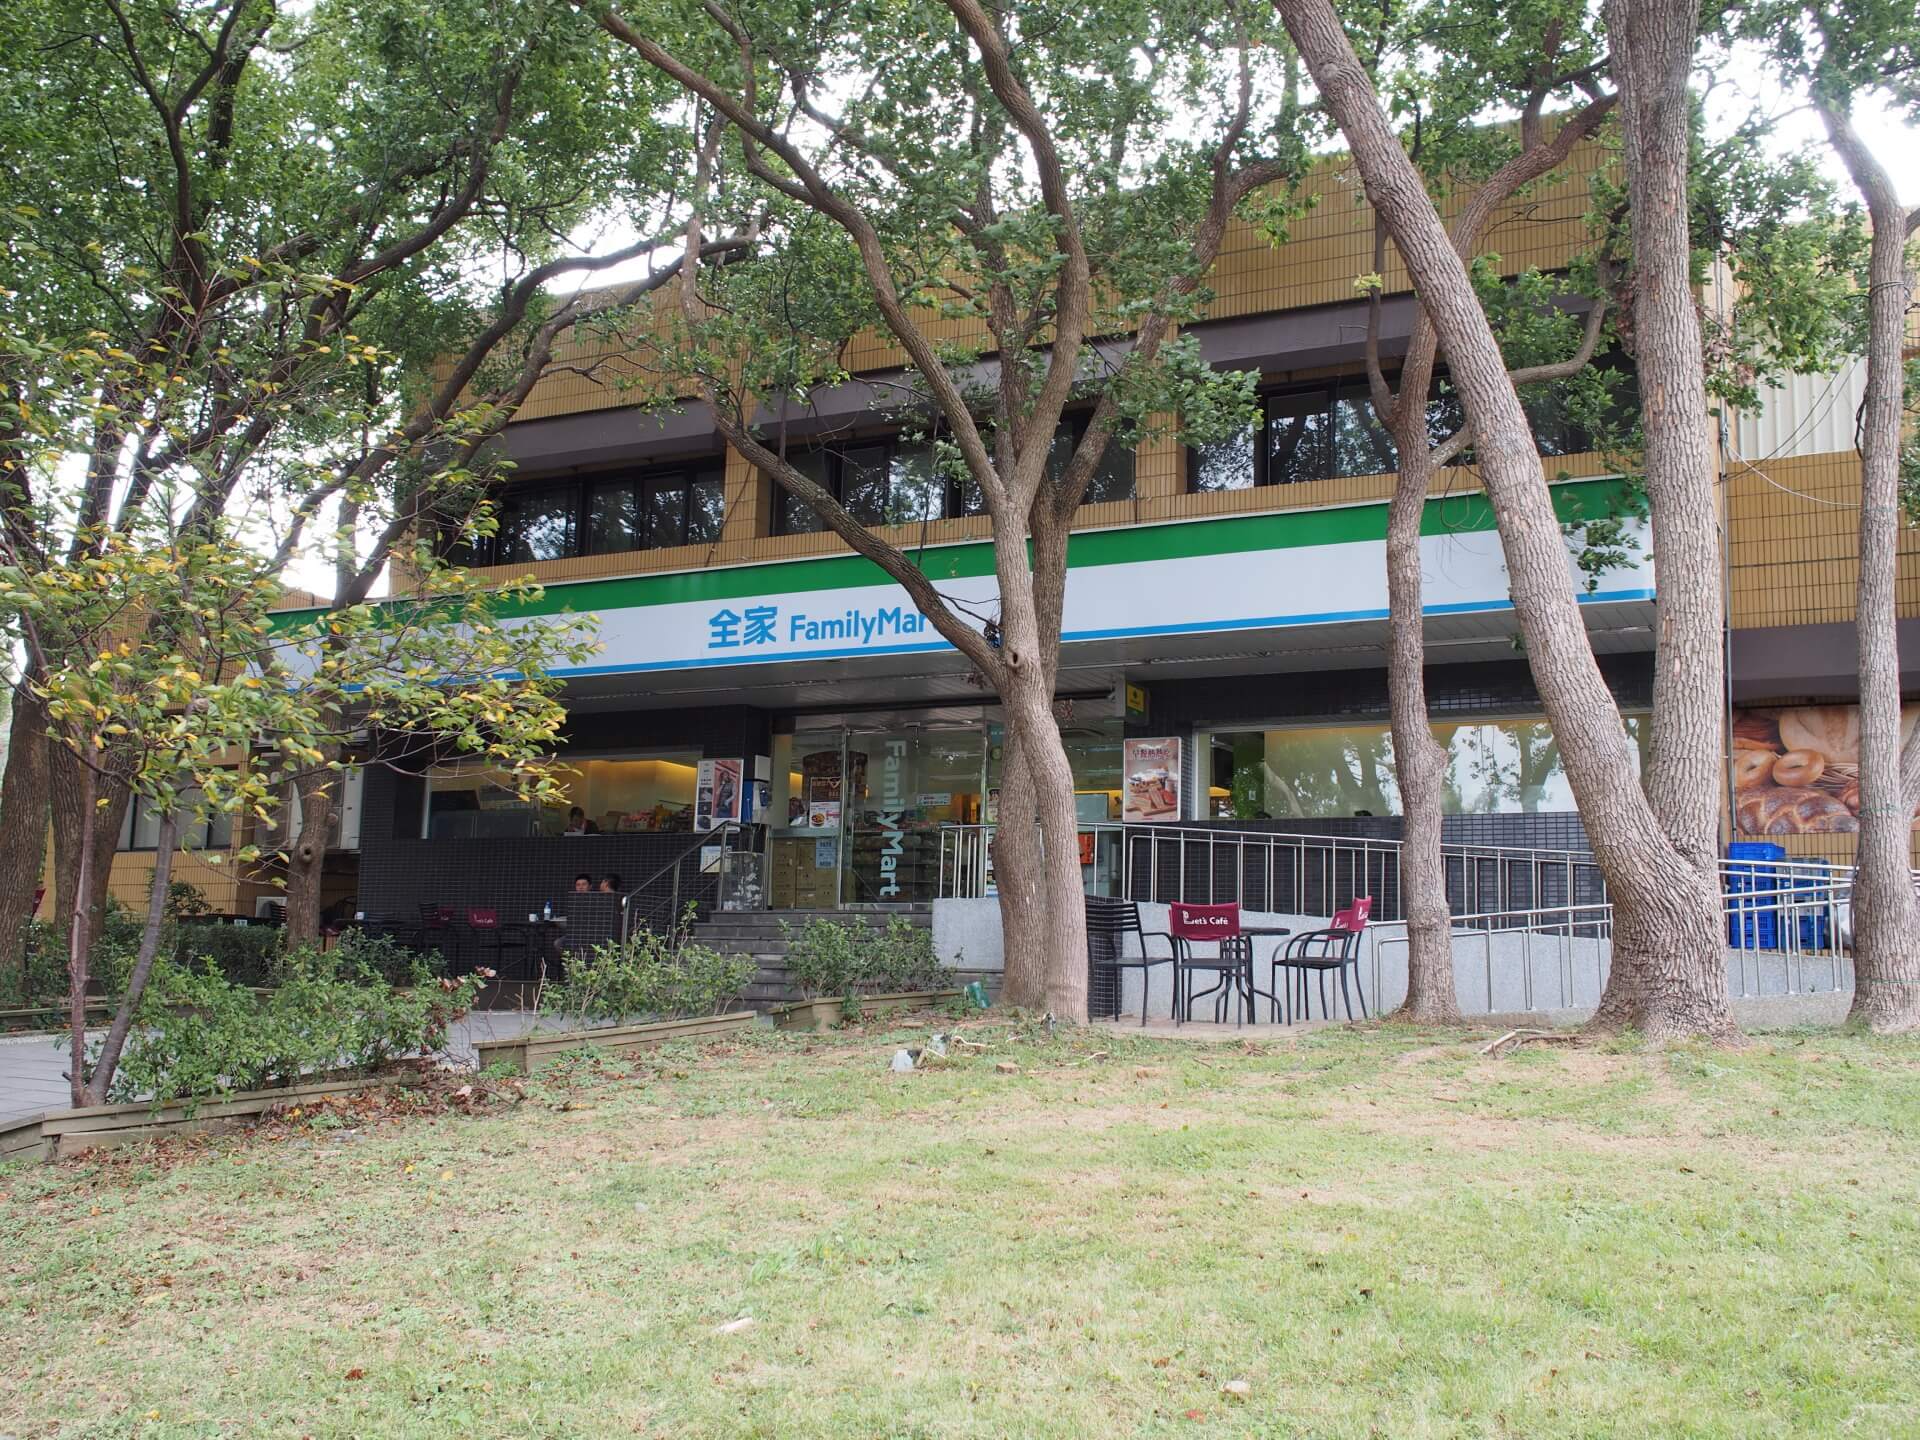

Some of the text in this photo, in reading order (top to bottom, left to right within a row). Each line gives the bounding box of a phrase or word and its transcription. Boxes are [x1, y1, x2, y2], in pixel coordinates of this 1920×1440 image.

[708, 605, 778, 649] 全家
[790, 606, 928, 644] FamilyMar
[876, 740, 907, 897] FamilyMart
